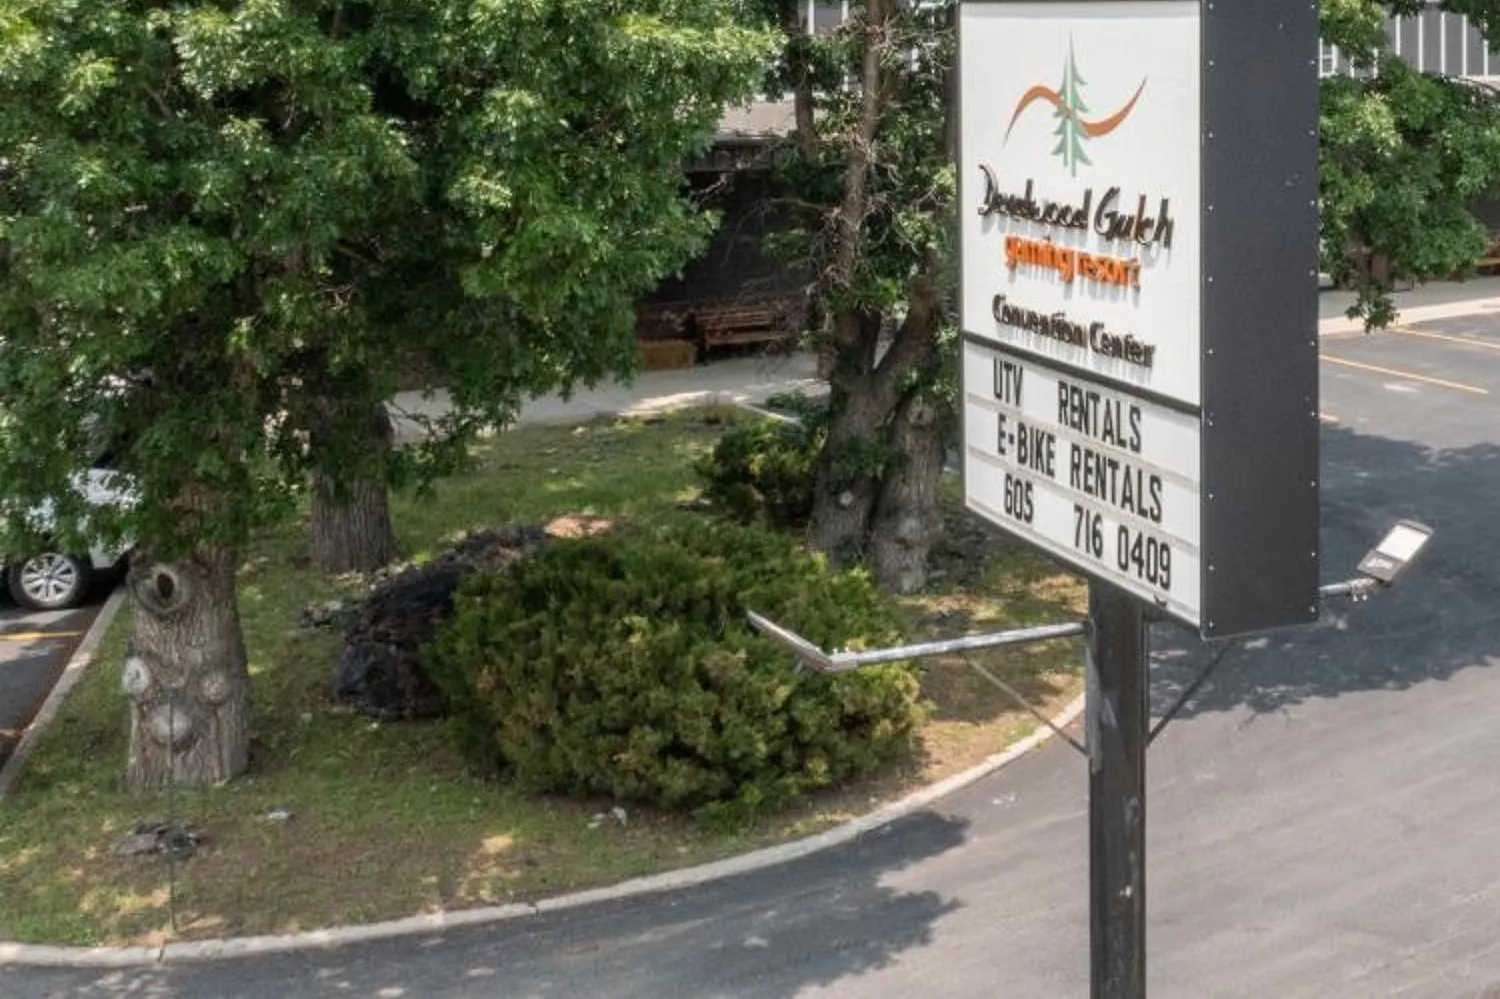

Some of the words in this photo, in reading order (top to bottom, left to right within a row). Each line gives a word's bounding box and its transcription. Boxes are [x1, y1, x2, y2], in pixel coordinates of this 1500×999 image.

[1094, 186, 1175, 250] Gulch
[992, 293, 1089, 349] Convention
[1088, 321, 1156, 368] Center
[992, 356, 1024, 407] UTV
[1057, 380, 1142, 453] RENTALS
[997, 412, 1056, 478] E-BIKE
[1069, 443, 1163, 524] RENTALS
[1003, 472, 1034, 525] 605
[1073, 503, 1105, 559] 716
[1116, 524, 1172, 592] 0409
